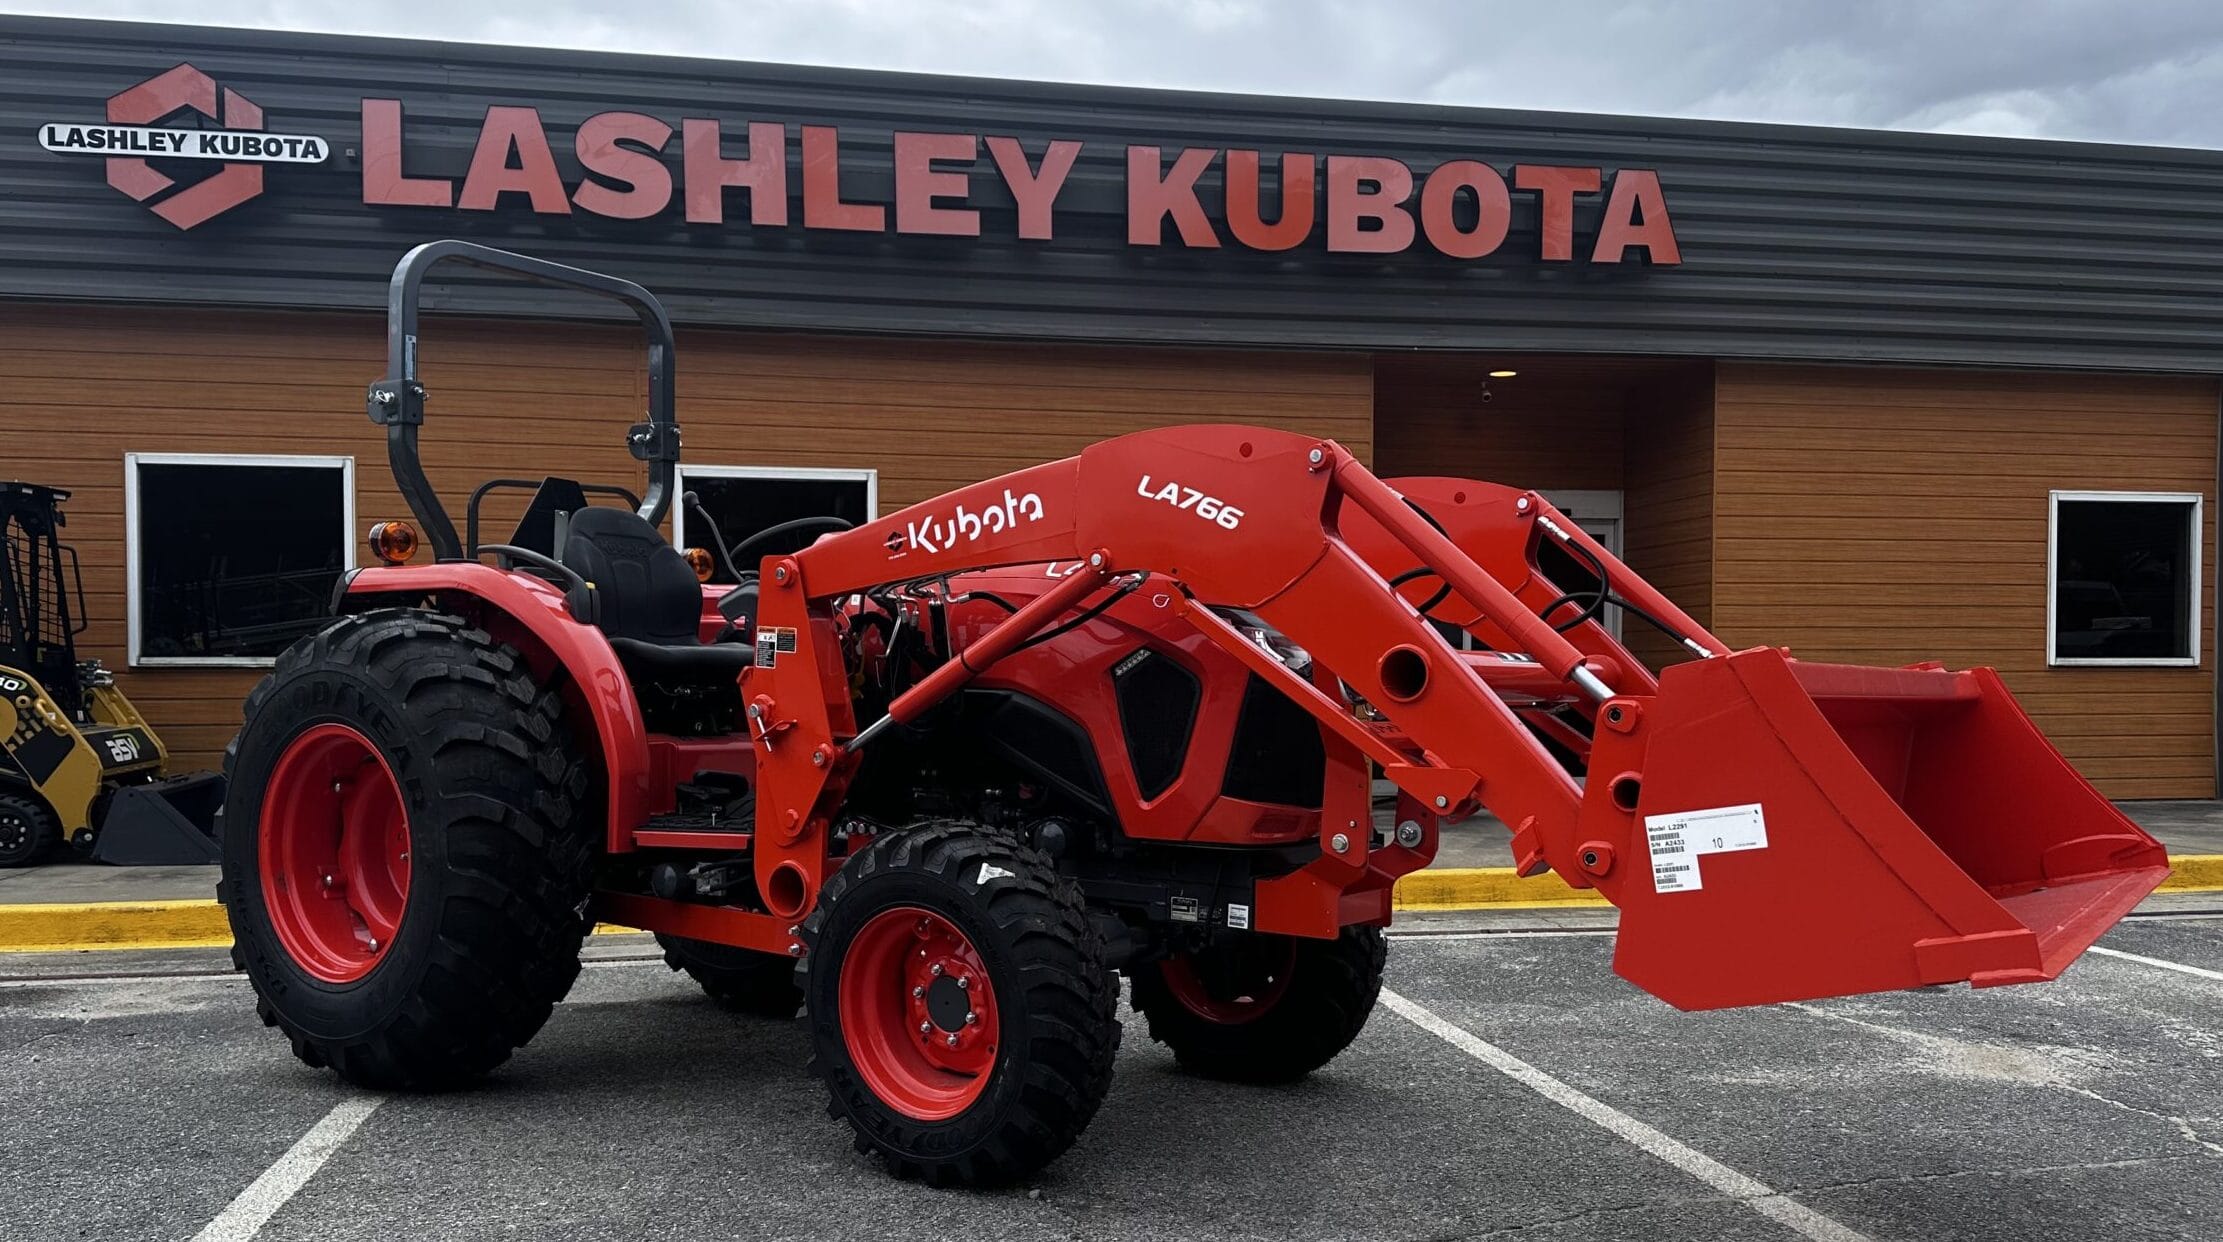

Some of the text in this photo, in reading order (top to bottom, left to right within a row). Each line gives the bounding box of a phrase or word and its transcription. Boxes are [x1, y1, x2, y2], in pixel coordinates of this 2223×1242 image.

[46, 126, 322, 159] LASHLEY KUBOTA
[361, 97, 1682, 265] LASHLEY KUBOTA
[907, 489, 1044, 553] Kubota
[1137, 475, 1245, 530] LA766
[1712, 837, 1723, 849] 10
